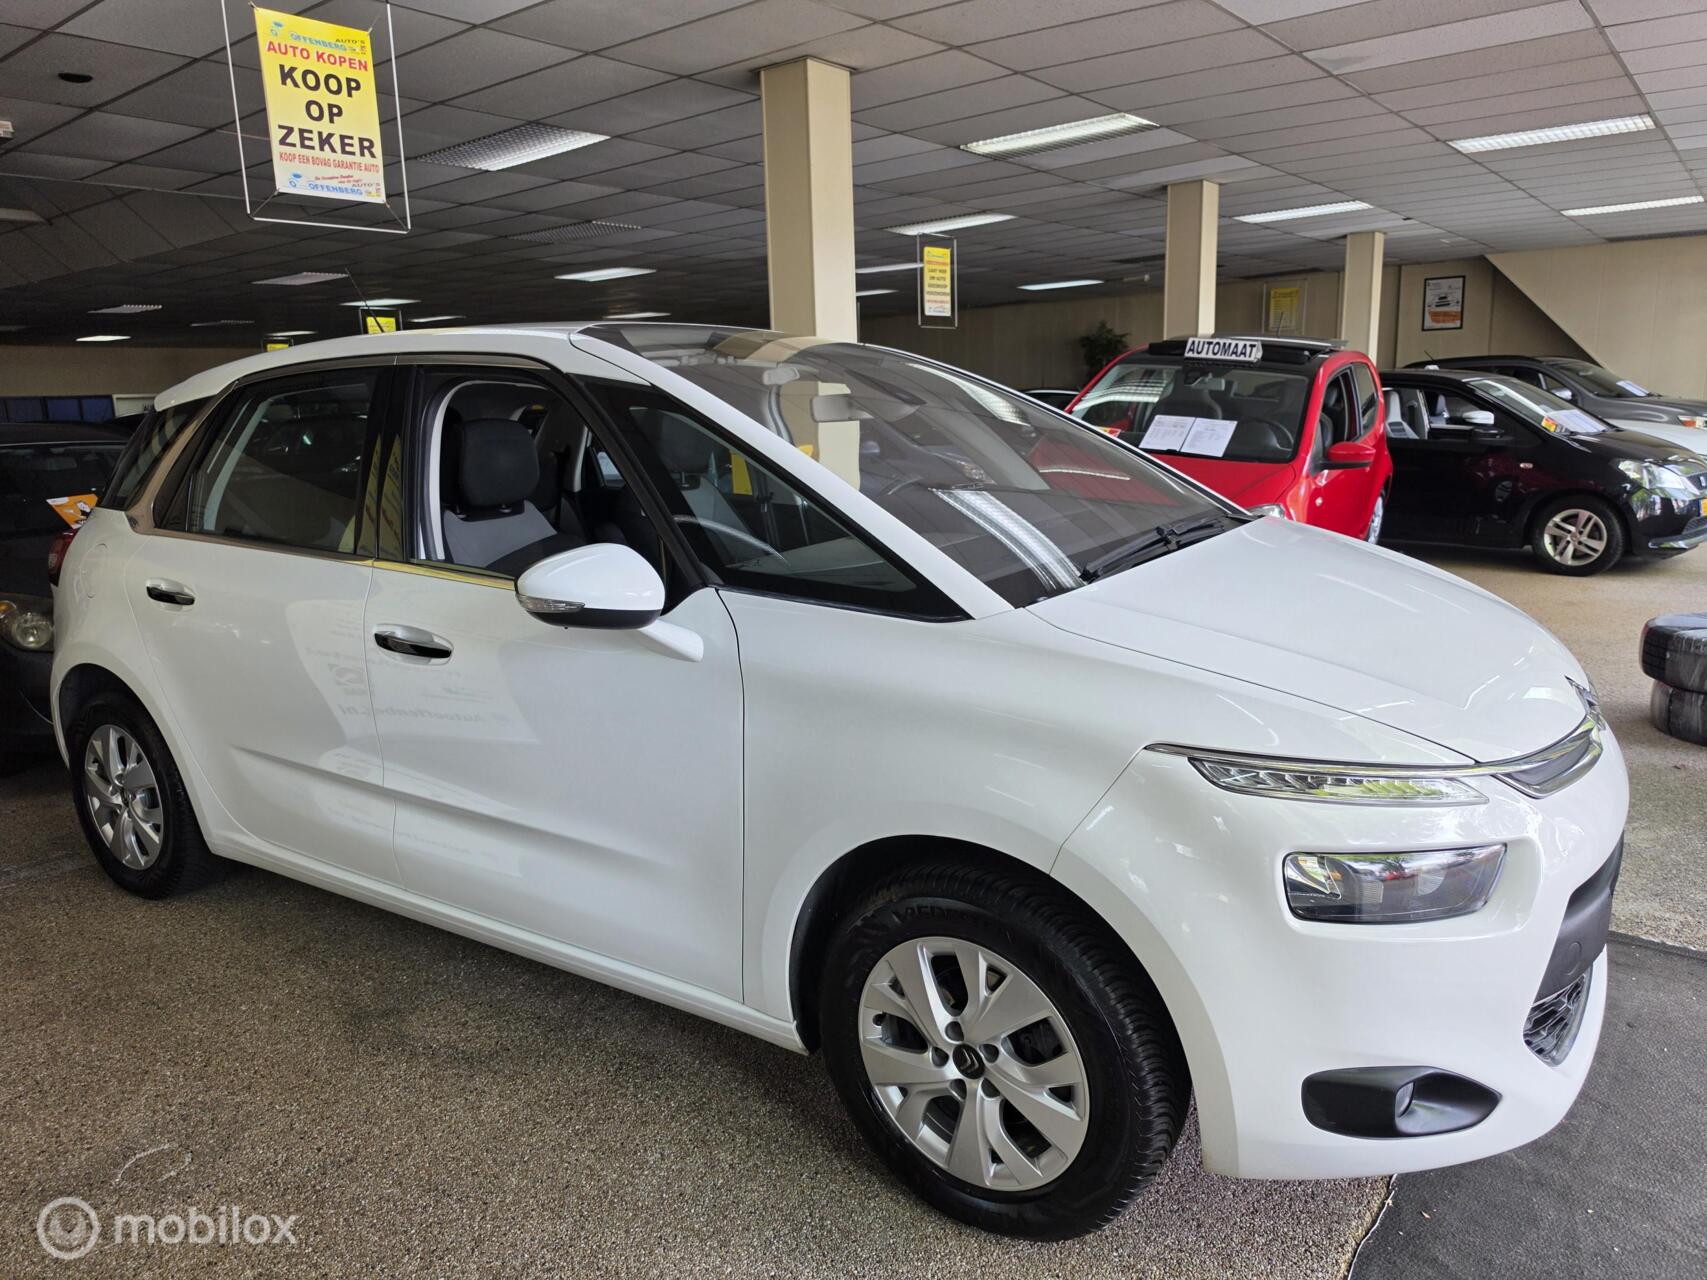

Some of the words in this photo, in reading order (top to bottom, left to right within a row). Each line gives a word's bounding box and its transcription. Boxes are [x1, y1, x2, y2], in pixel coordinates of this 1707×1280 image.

[266, 40, 311, 61] AUTO
[316, 50, 369, 72] KOPEN
[278, 64, 361, 98] KOOP
[305, 99, 343, 124] OP
[277, 124, 377, 159] ZEKER
[279, 152, 296, 162] KOOP
[298, 155, 311, 165] EEN
[311, 156, 332, 168] BOVAG
[332, 159, 363, 171] GARANTIE
[363, 164, 380, 174] AUTO
[1186, 340, 1257, 358] AUTOMAAT
